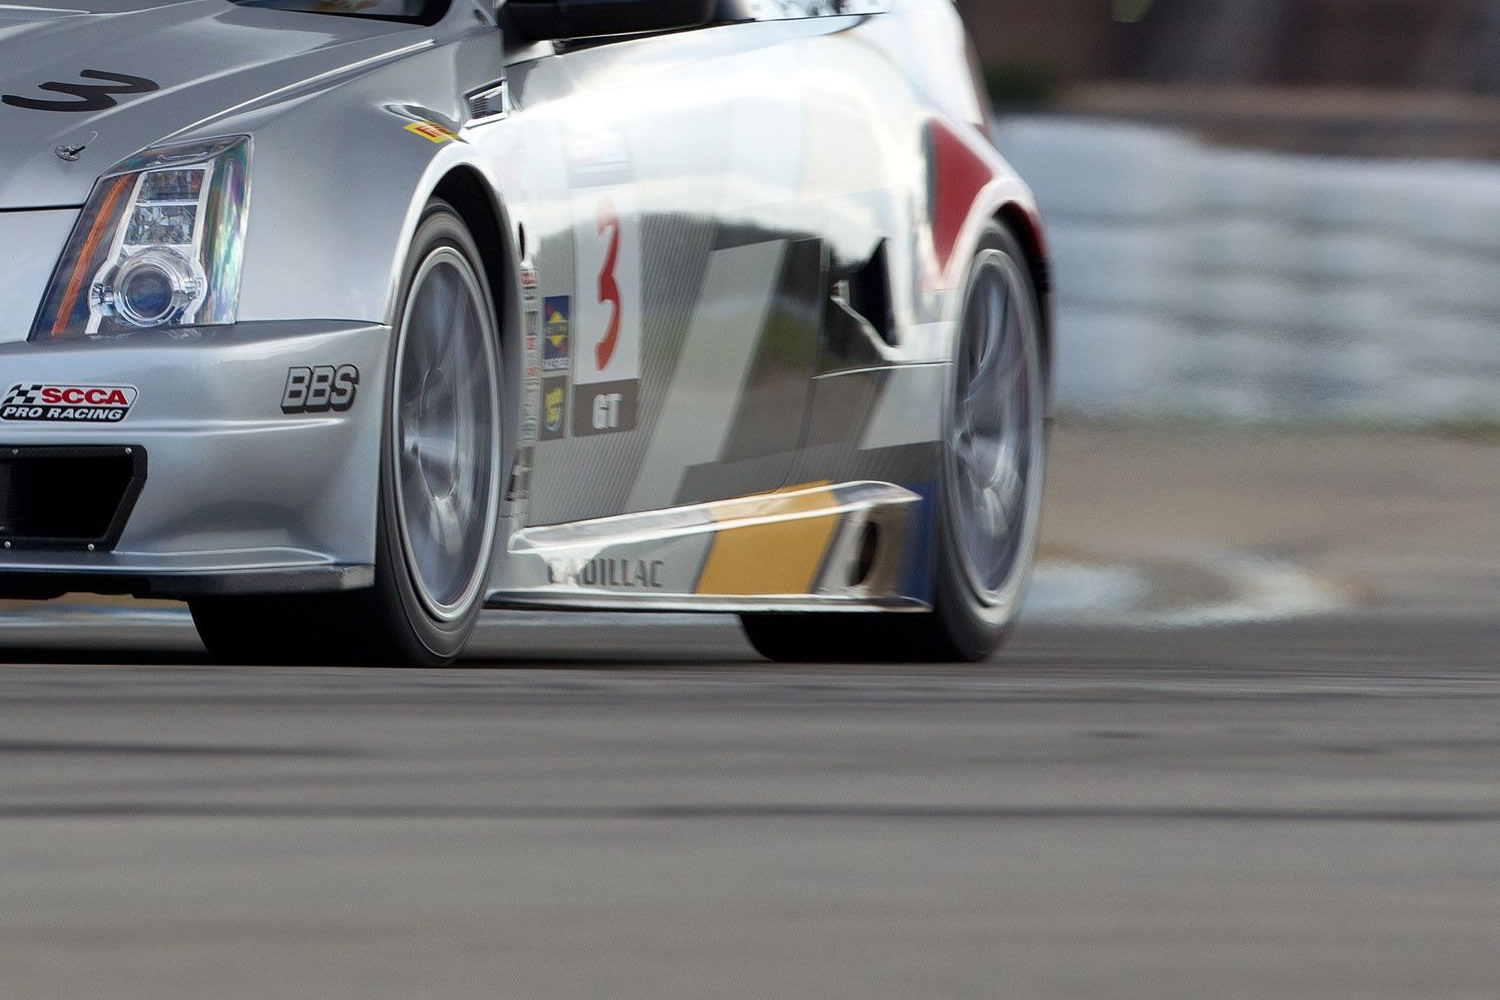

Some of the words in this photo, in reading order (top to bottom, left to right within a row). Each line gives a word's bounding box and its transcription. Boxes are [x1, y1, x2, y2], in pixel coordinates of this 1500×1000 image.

[1, 69, 160, 112] 3
[594, 198, 621, 372] 3
[41, 388, 128, 406] SCCA
[280, 363, 360, 415] BBS
[2, 406, 43, 418] PRO
[46, 407, 124, 420] RACING
